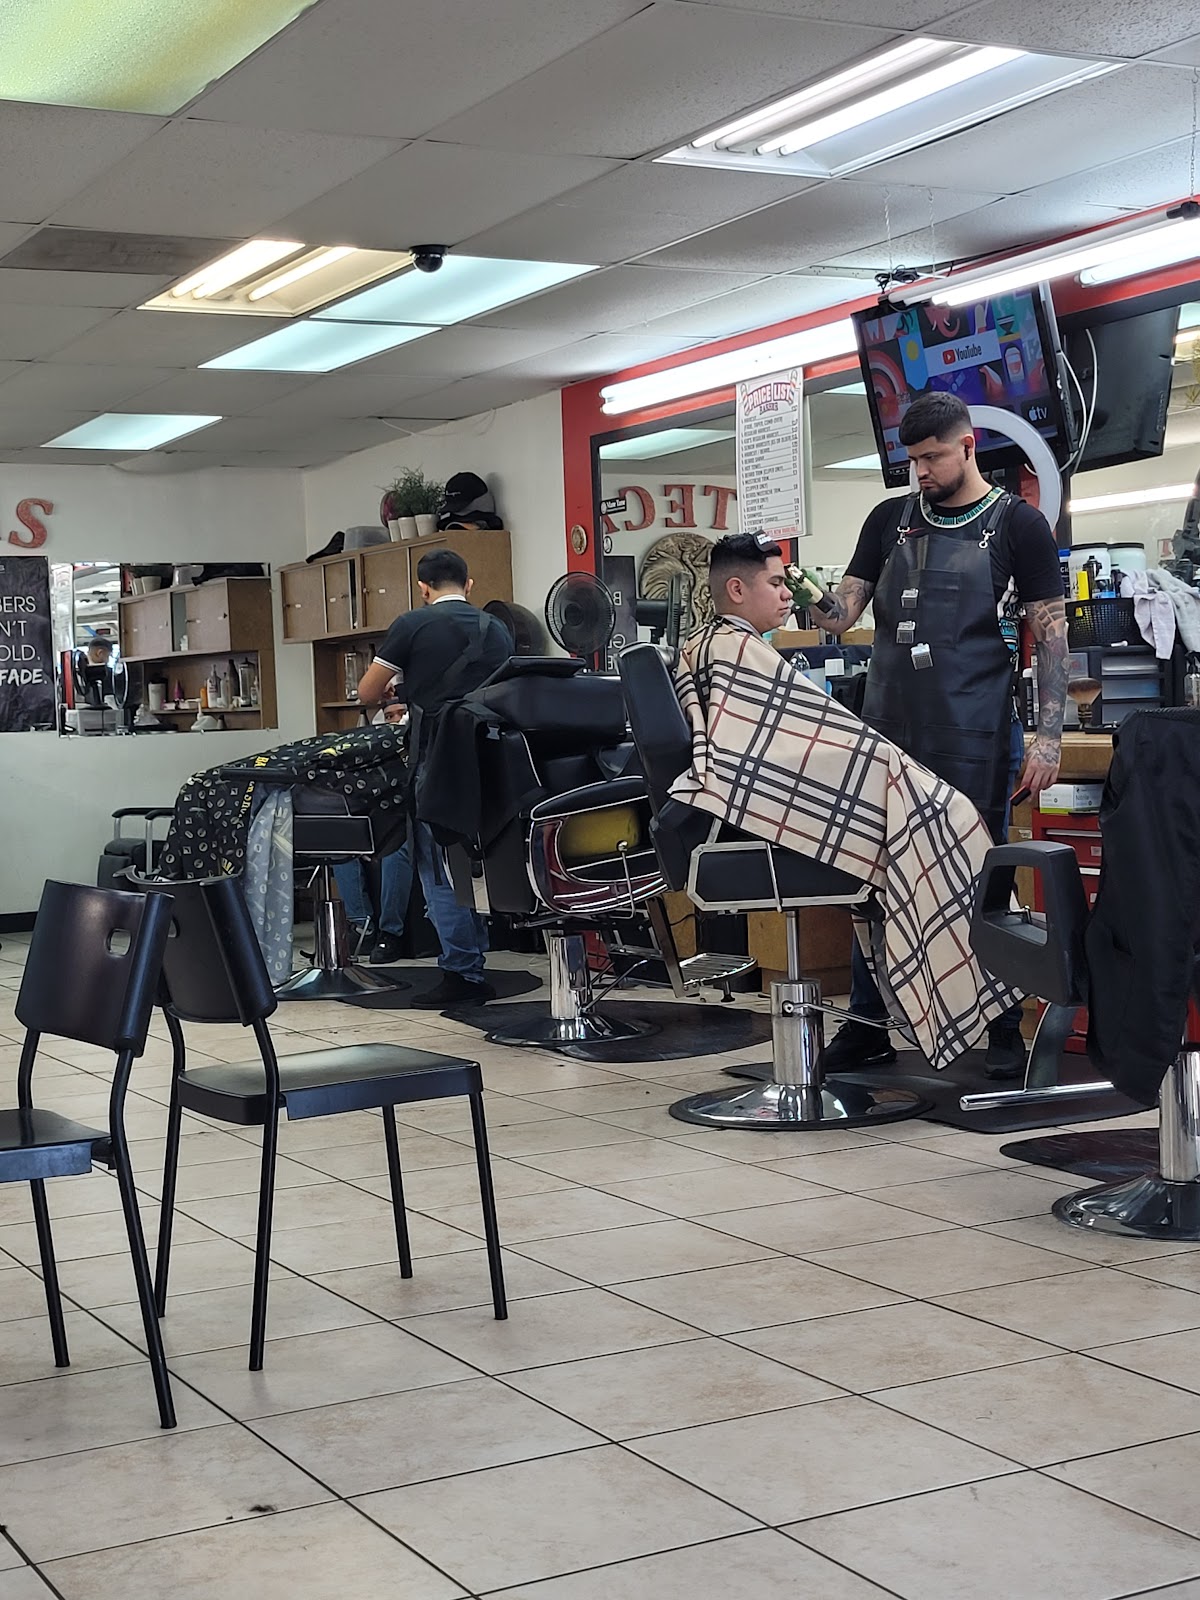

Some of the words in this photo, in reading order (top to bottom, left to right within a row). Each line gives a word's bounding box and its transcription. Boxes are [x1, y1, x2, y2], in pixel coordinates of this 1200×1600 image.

[955, 344, 982, 362] YouTube
[748, 384, 771, 411] PRICE
[773, 383, 792, 402] LIST
[1036, 407, 1047, 421] tv
[2, 498, 54, 548] S
[0, 669, 48, 687] FADE.
